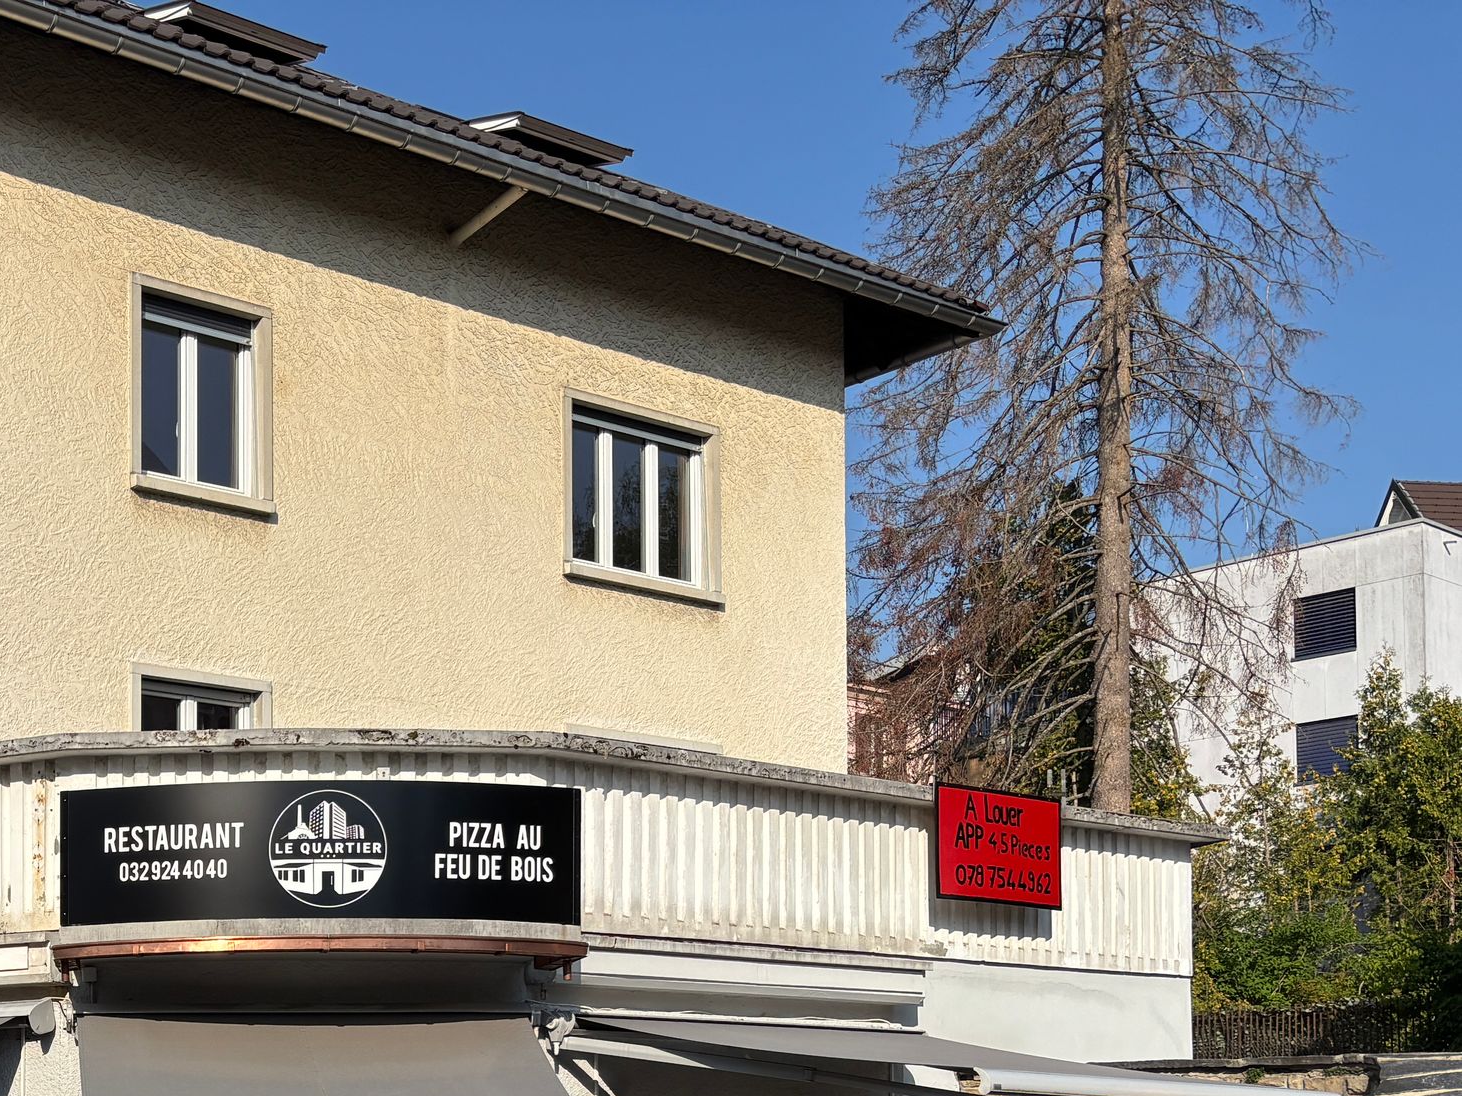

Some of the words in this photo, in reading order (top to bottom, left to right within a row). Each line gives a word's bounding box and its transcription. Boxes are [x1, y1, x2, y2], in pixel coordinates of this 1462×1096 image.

[964, 794, 978, 821] A
[104, 822, 244, 853] RESTAURANT
[275, 842, 293, 854] LE
[300, 842, 382, 855] QUARTIER
[449, 821, 505, 849] PIZZA
[516, 825, 541, 850] AU
[954, 821, 984, 849] APP
[434, 853, 471, 879] FEU
[478, 854, 502, 880] DE
[511, 855, 553, 883] BOIS
